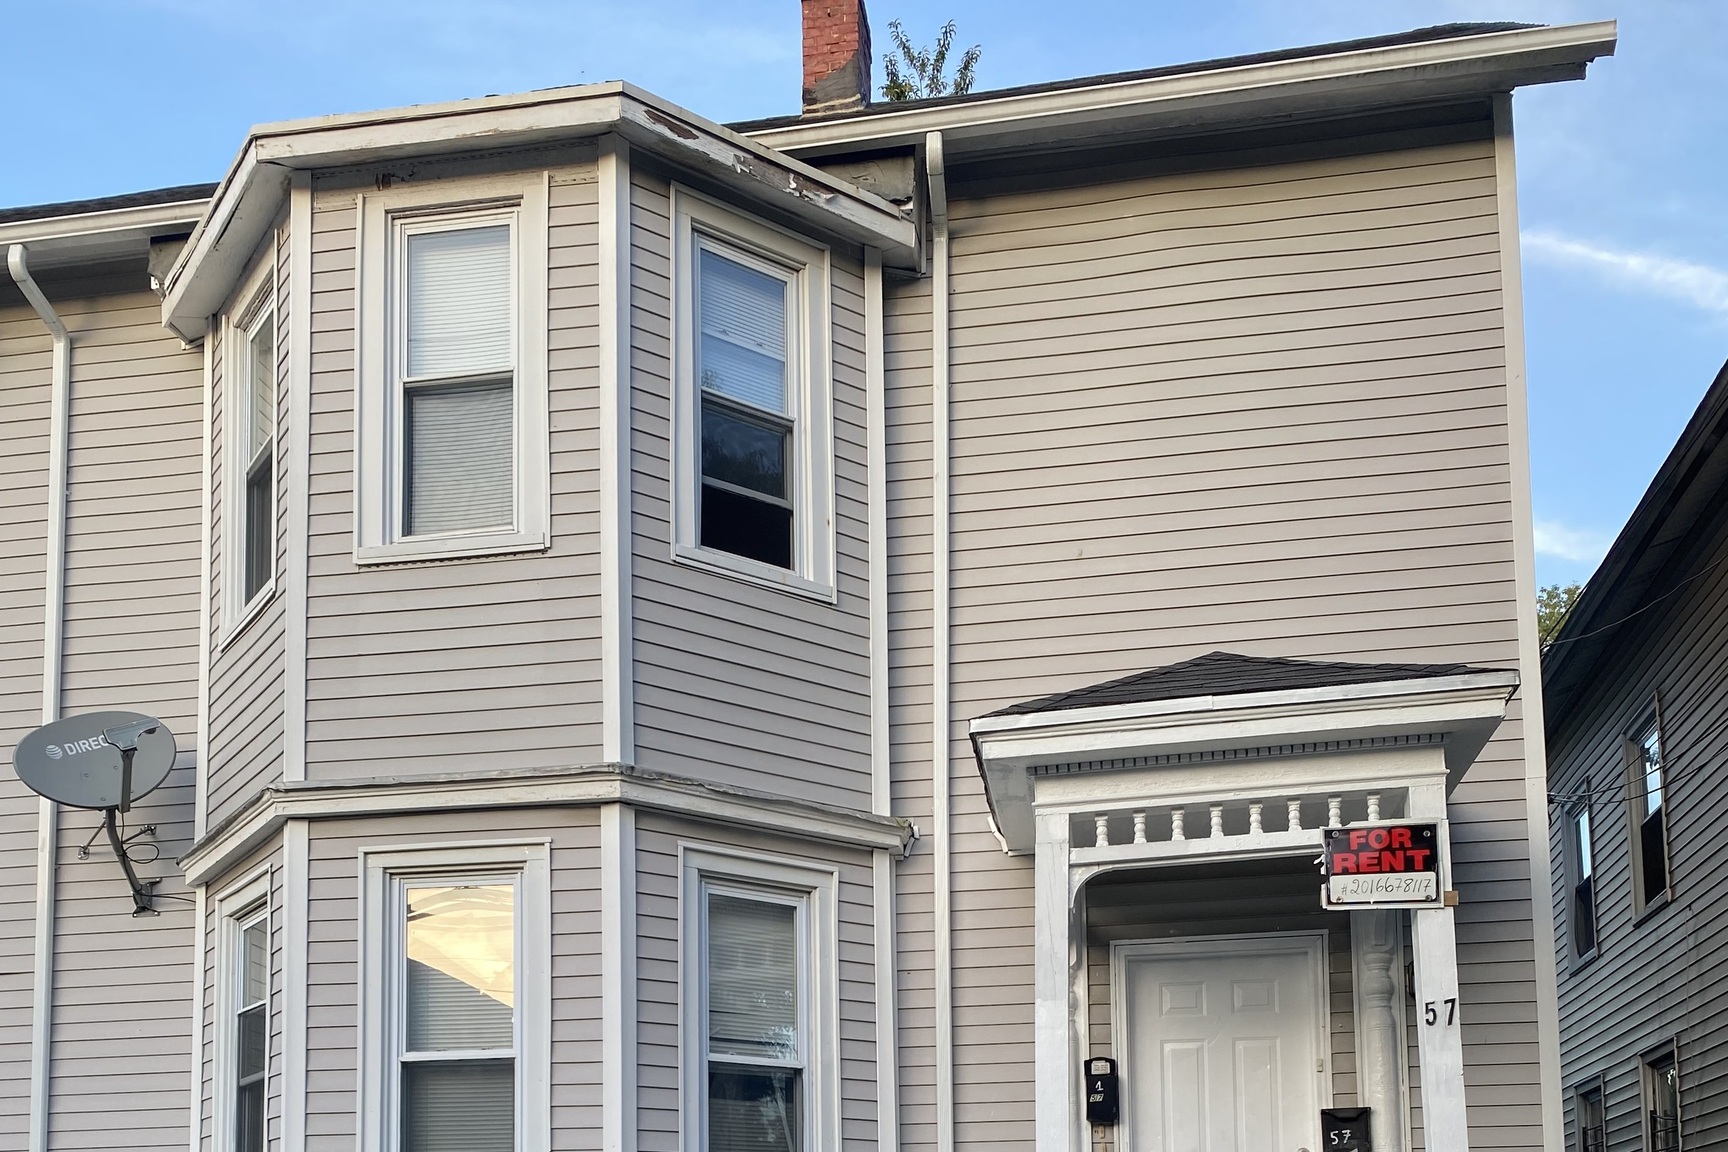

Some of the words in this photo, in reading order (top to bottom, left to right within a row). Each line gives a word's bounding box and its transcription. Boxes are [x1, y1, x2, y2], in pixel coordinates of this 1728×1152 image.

[64, 735, 109, 755] DIREC
[1349, 828, 1412, 850] FOR
[1333, 850, 1431, 873] RENT
[1341, 877, 1431, 896] #2016678117
[1425, 998, 1456, 1026] 57
[1095, 1080, 1104, 1091] 1
[1090, 1094, 1104, 1102] 57
[1330, 1129, 1351, 1145] 57
